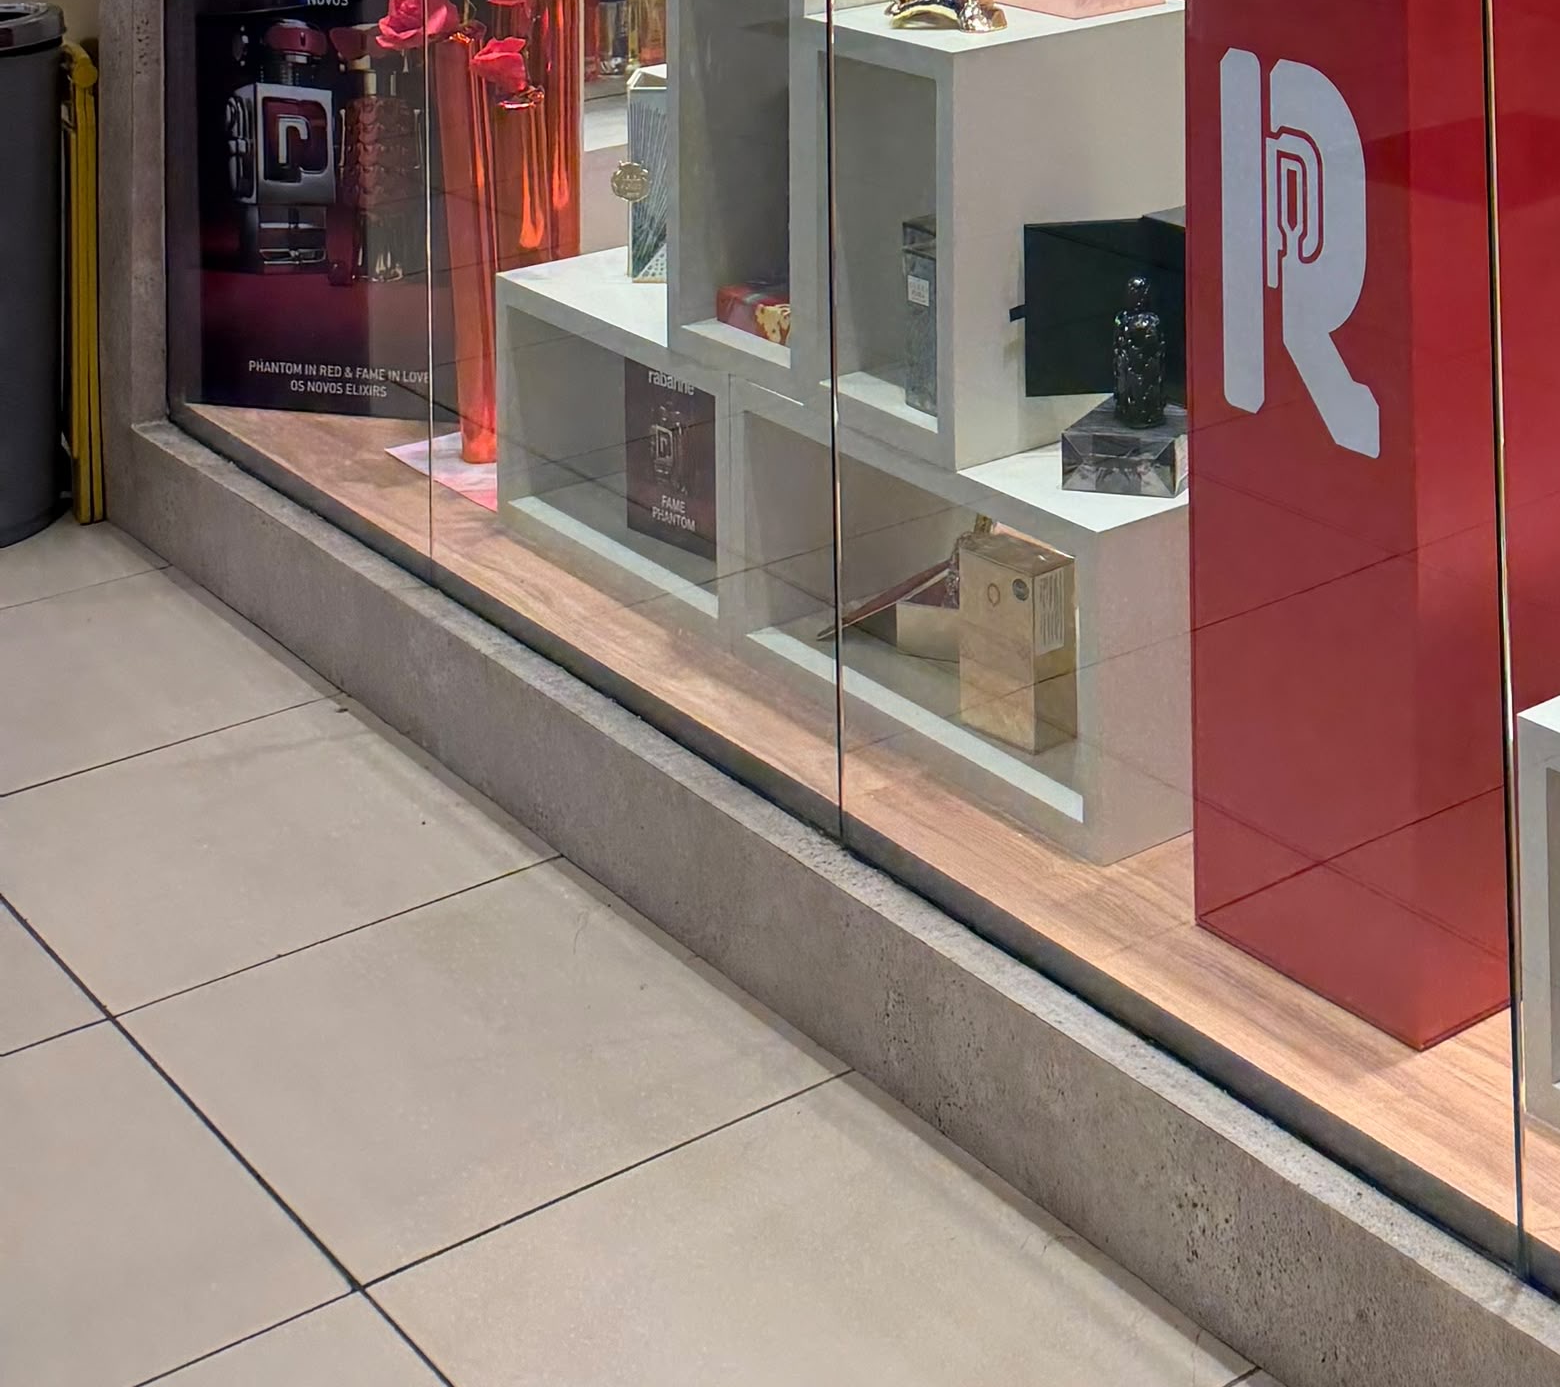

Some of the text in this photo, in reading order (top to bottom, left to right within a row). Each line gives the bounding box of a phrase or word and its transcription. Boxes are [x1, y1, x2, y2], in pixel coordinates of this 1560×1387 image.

[249, 360, 301, 376] PHANTOM
[304, 364, 317, 376] IN
[319, 365, 342, 378] RED
[356, 367, 385, 381] FAME
[388, 370, 400, 382] IN
[290, 379, 387, 397] OS NOVOS ELIXIRS
[661, 494, 686, 514] FAME
[652, 506, 696, 532] PHANTOM
